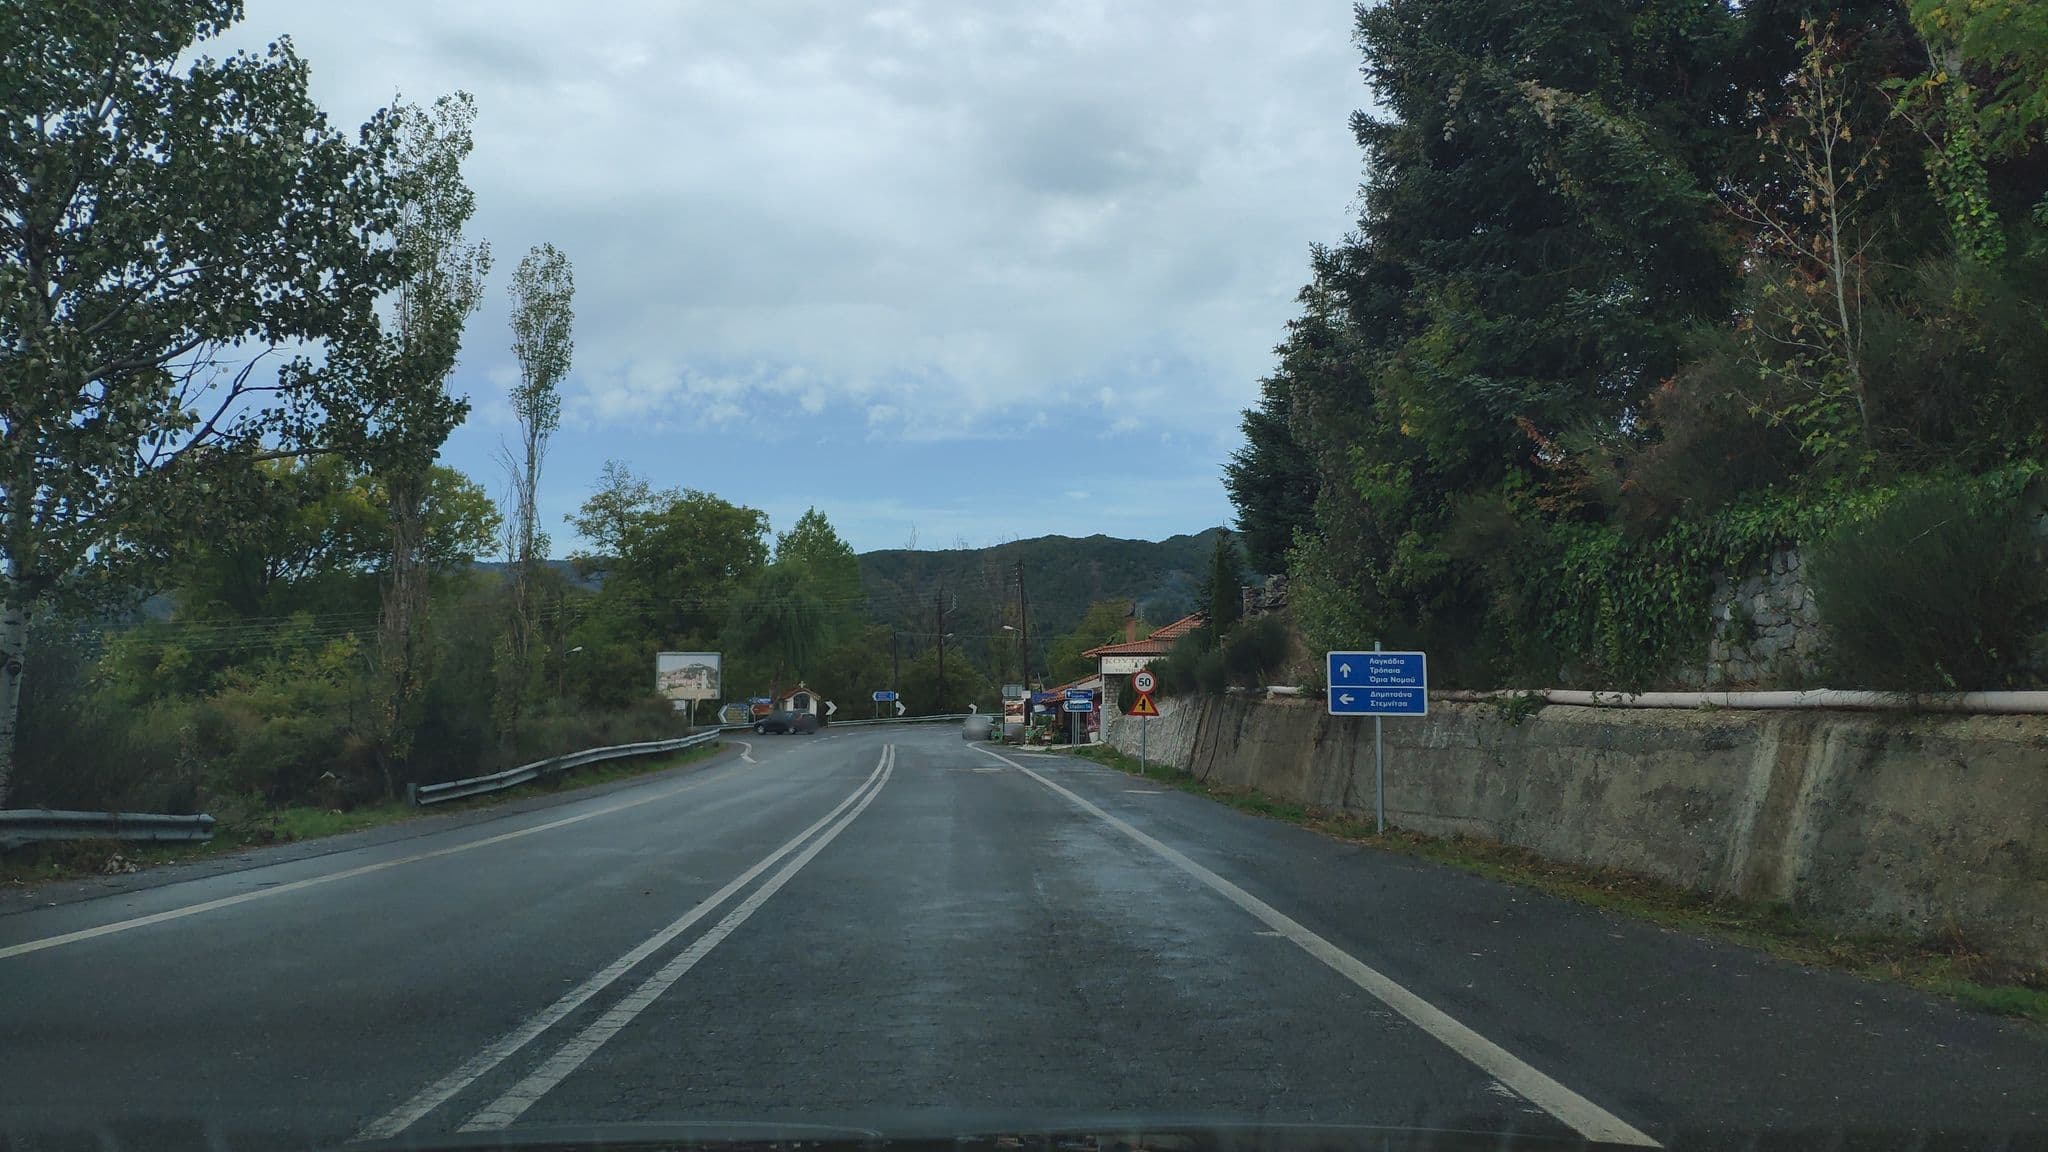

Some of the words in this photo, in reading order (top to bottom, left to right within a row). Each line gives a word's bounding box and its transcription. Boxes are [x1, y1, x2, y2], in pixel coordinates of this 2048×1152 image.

[1138, 678, 1150, 686] 50
[1370, 690, 1412, 698] Δημητσάνα
[1370, 700, 1408, 708] Στεμνίτσα
